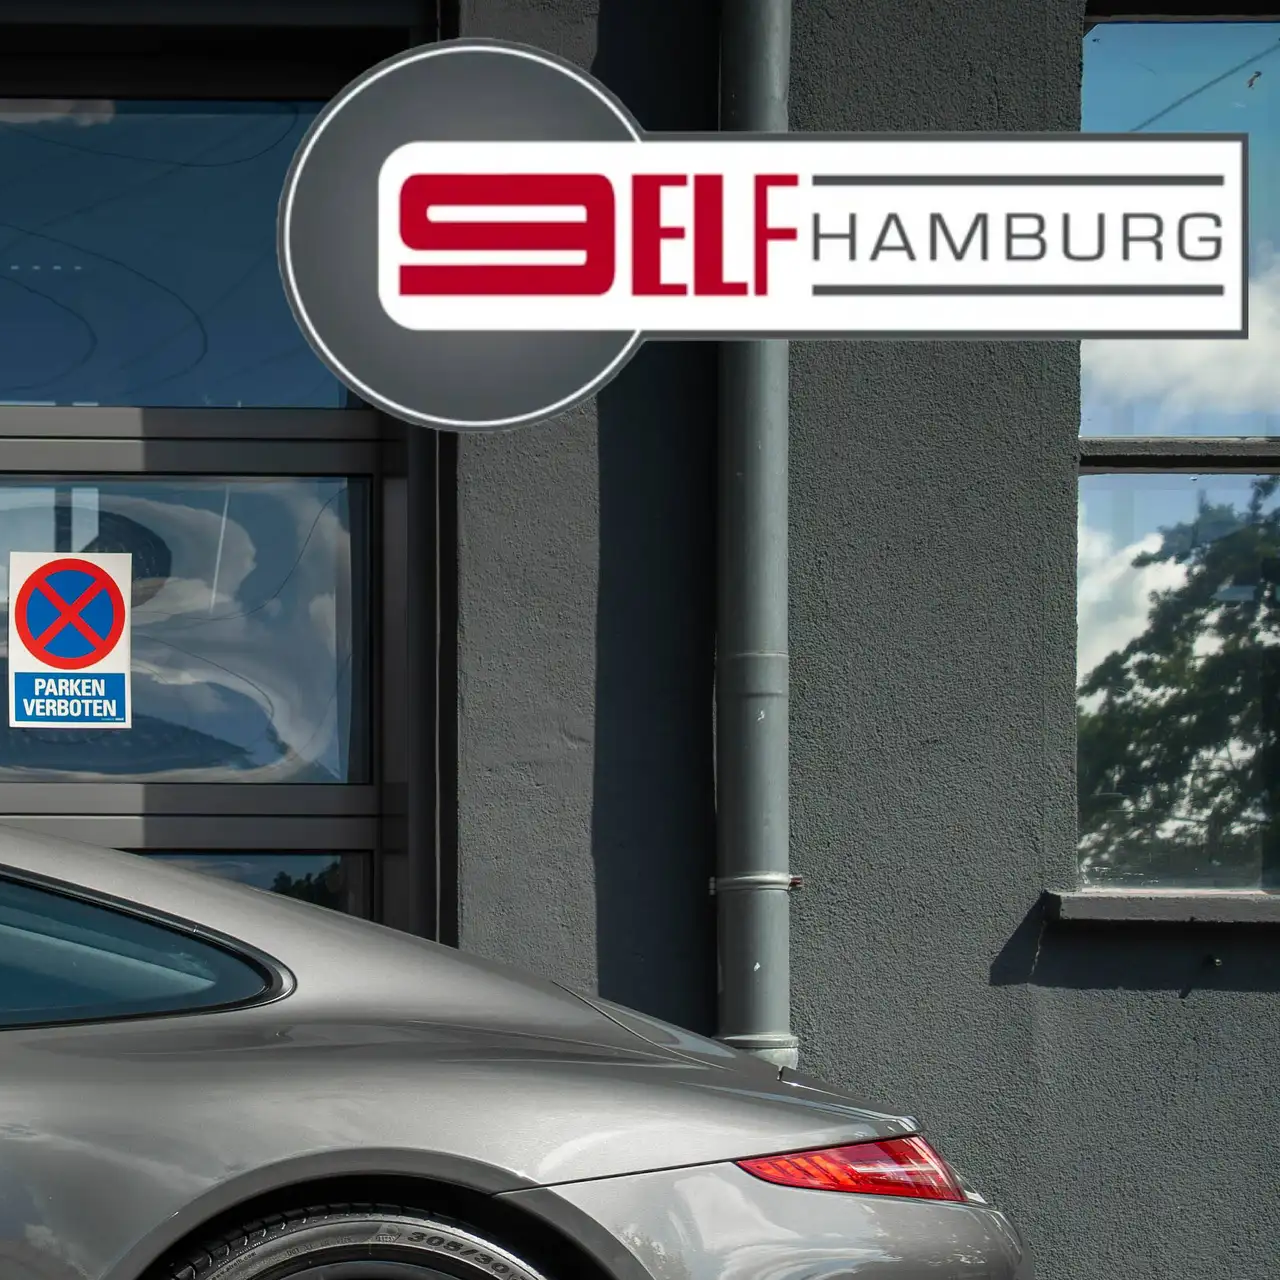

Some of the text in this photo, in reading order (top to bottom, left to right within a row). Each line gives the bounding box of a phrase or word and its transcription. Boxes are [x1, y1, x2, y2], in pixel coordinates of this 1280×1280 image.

[34, 678, 105, 697] PARKEN
[22, 698, 117, 717] VERBOTEN
[406, 1231, 511, 1274] 305/30
